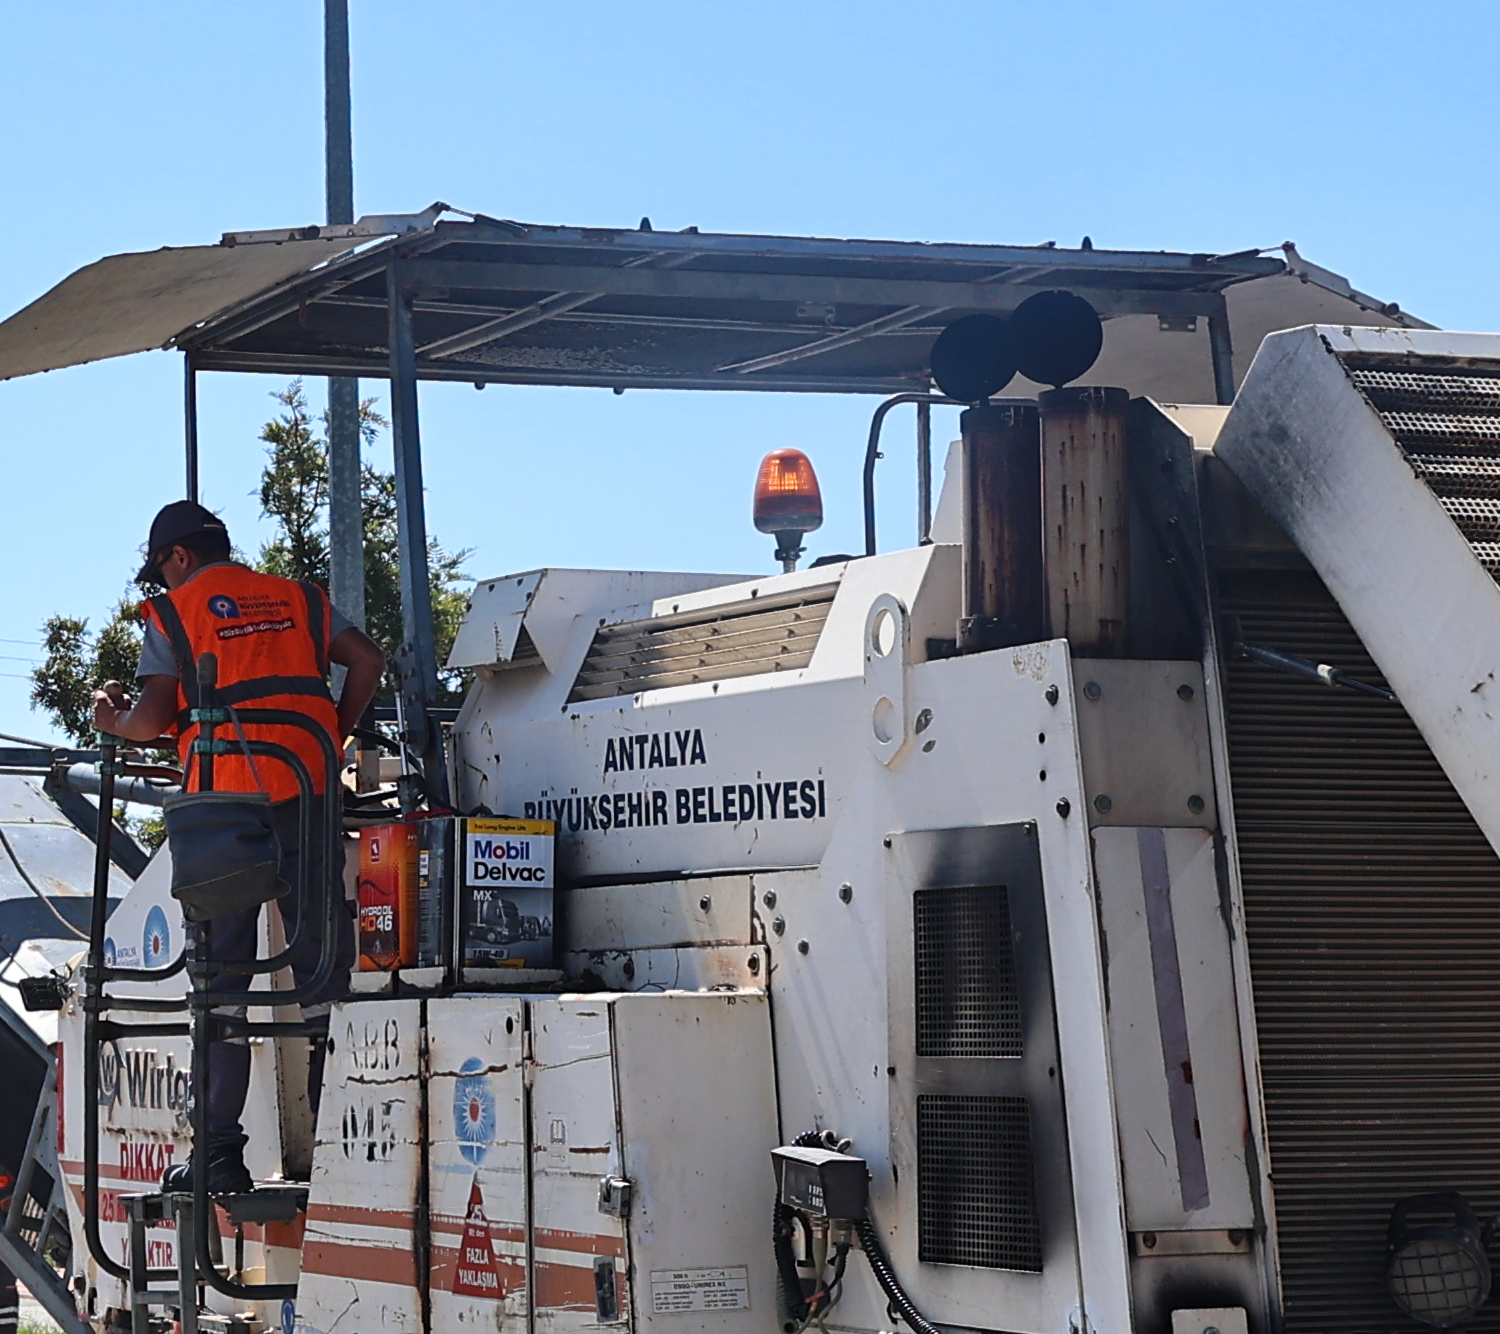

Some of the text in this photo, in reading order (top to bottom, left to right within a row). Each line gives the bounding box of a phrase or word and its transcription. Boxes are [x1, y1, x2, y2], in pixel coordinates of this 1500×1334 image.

[603, 728, 707, 773] ANTALYA
[675, 767, 826, 825] BELEDİYESİ
[474, 840, 530, 860] Mobil
[473, 862, 546, 882] Delvac
[125, 1049, 189, 1128] Wirtg
[120, 1141, 174, 1181] DİKKAT
[121, 1237, 177, 1268] YKTIR.
[466, 1247, 490, 1265] FAZLA
[458, 1268, 498, 1291] YAKLAŞMA
